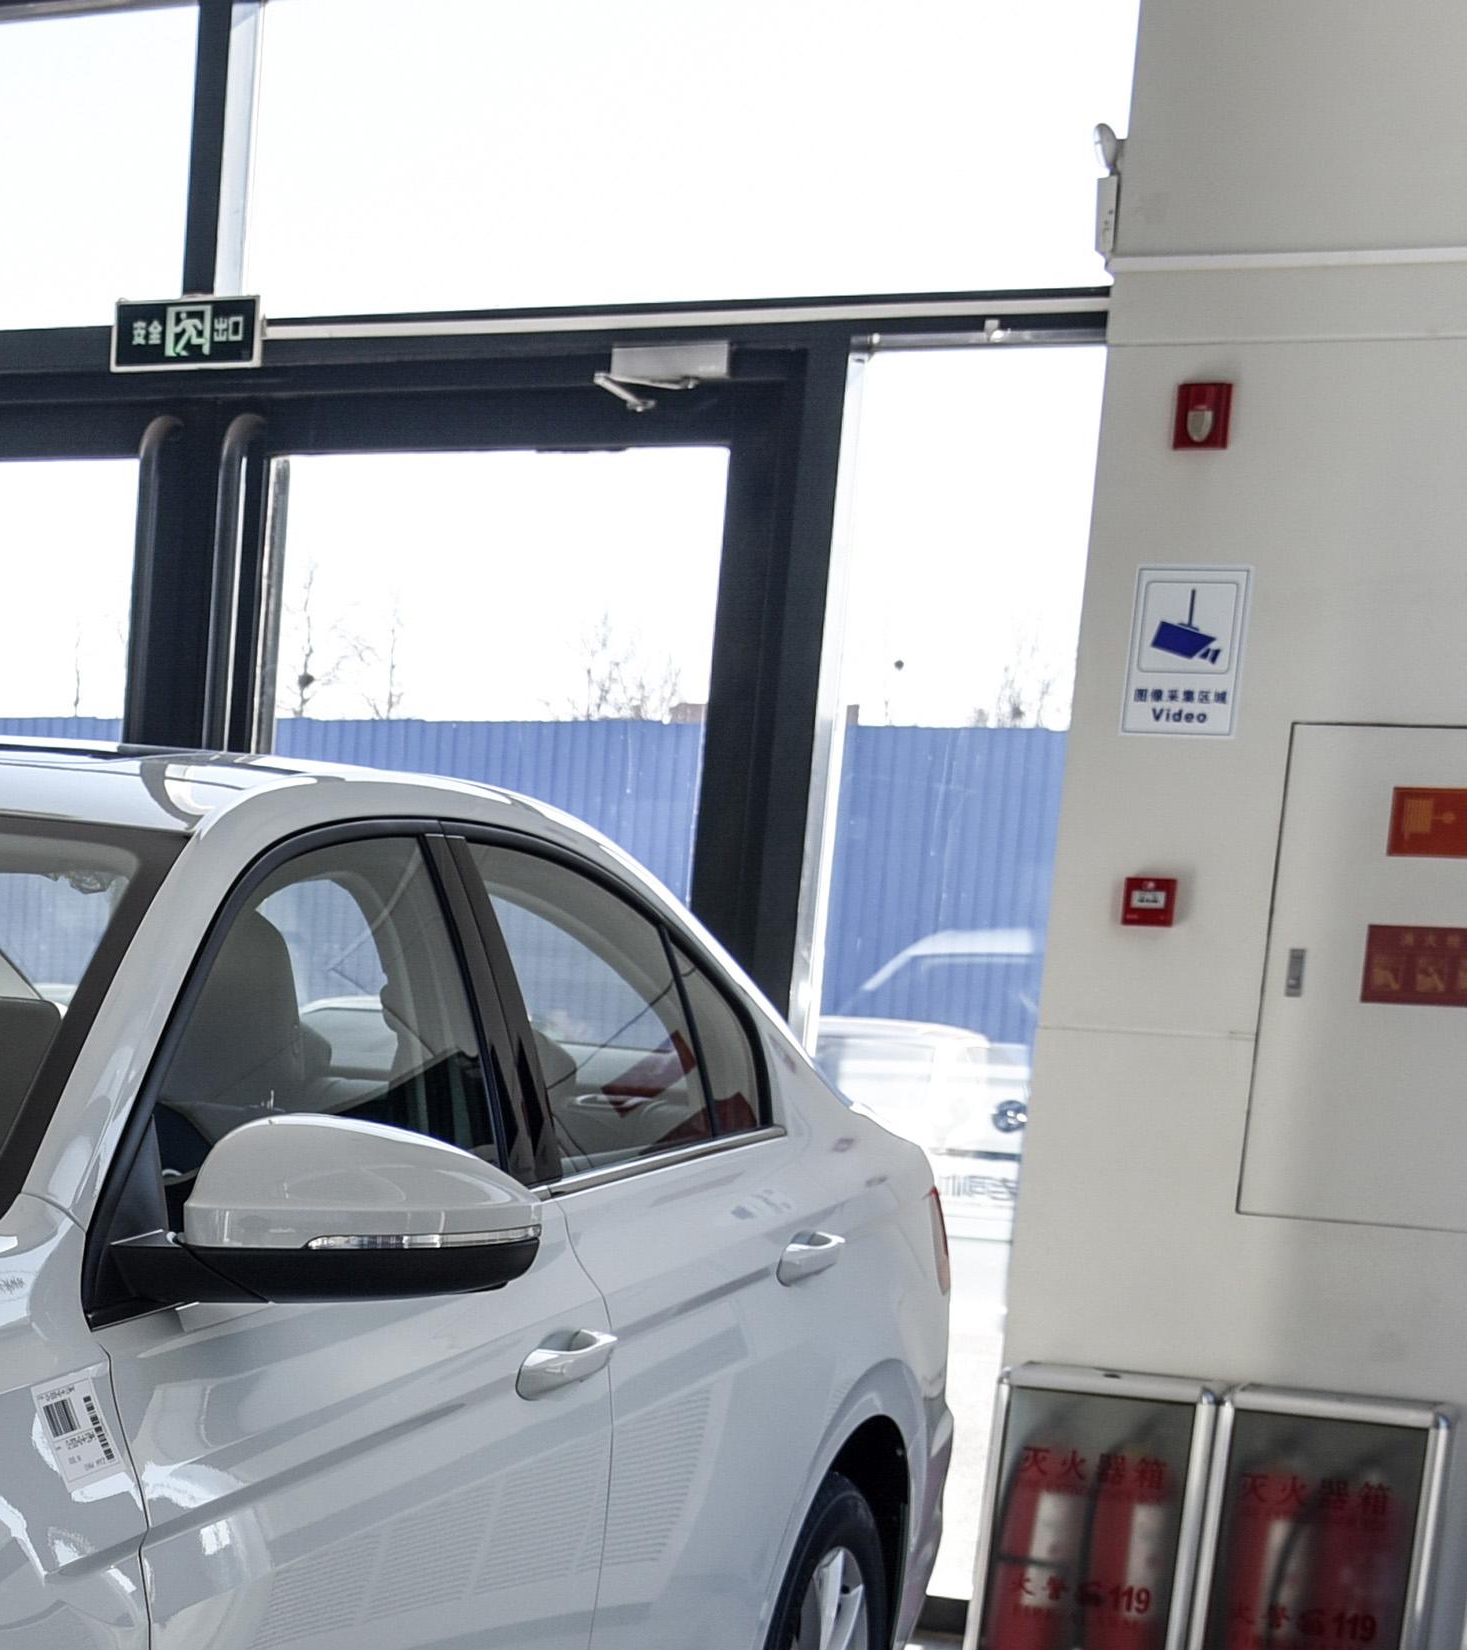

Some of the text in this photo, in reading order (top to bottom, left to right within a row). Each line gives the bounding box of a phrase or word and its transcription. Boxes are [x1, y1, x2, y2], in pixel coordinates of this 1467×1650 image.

[131, 315, 244, 346] 安全 出口
[1151, 707, 1209, 725] Video
[1022, 1445, 1170, 1490] 灭火器箱
[1240, 1472, 1390, 1517] 灭火器箱
[1108, 1584, 1153, 1615] 119
[1331, 1612, 1378, 1643] 119
